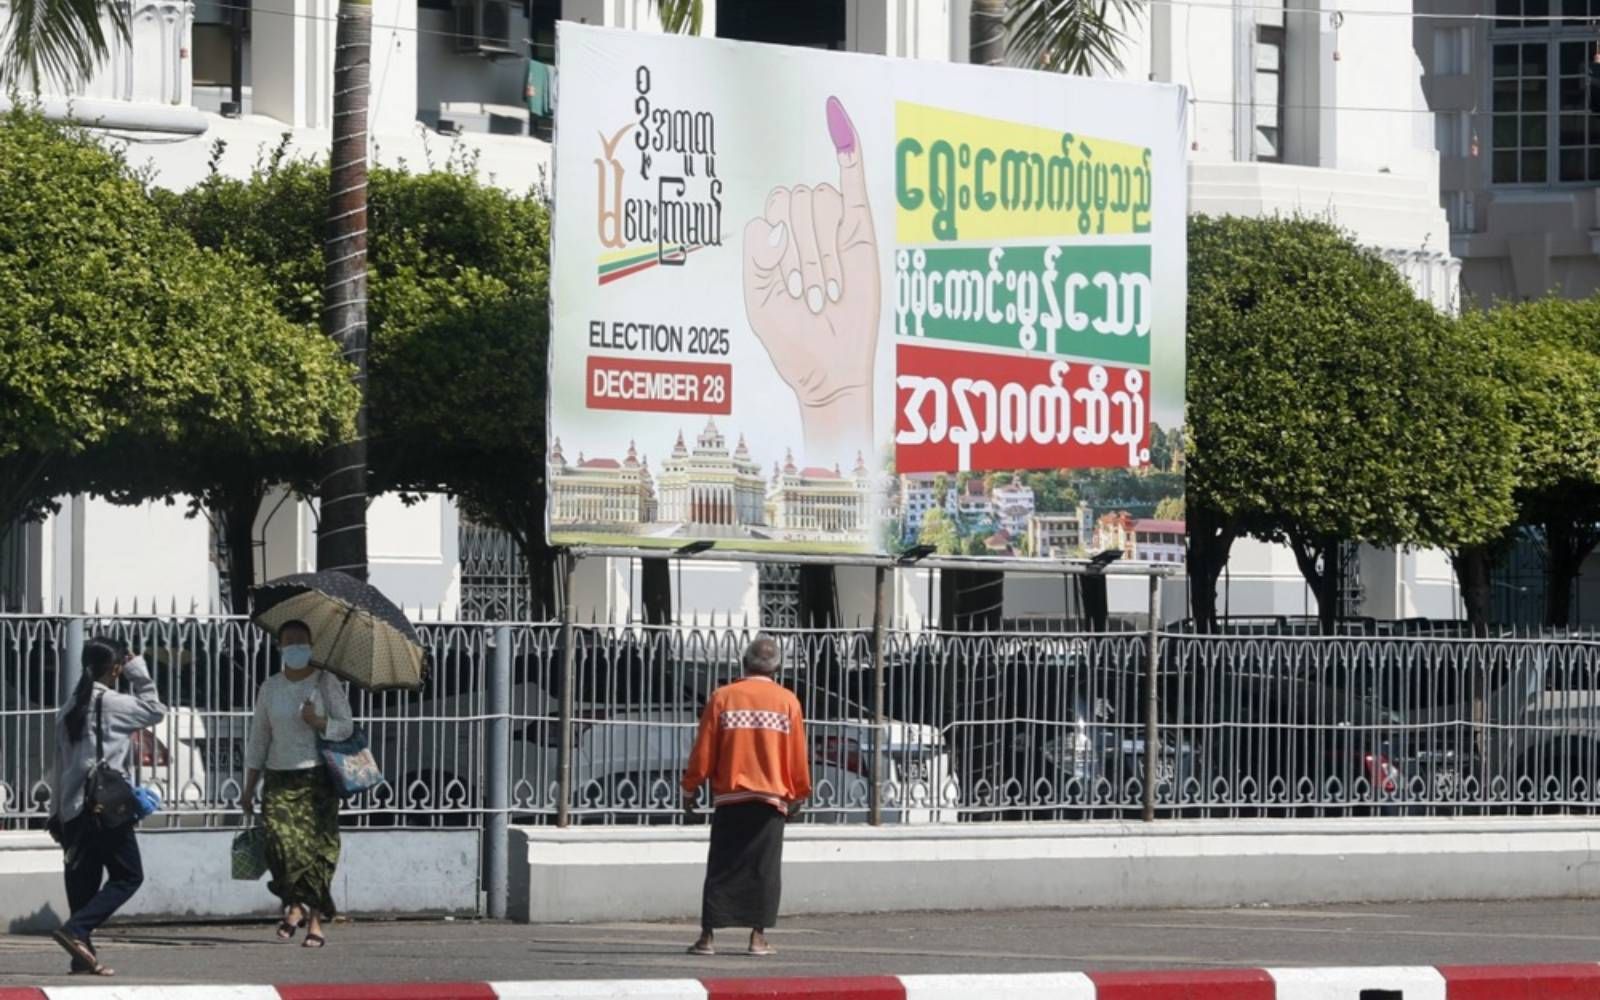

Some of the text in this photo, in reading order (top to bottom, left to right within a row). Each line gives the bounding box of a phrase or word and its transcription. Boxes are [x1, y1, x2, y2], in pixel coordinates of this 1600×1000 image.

[896, 132, 1152, 241] ရွေးကောက်ပွဲမှသည်
[589, 320, 730, 355] ELECTION 2025
[896, 245, 1152, 355] ပိုမိုကောင်းမွန်သော
[593, 369, 726, 404] DECEMBER 28
[896, 361, 1151, 471] အနာဂတ်ဆီသို့
